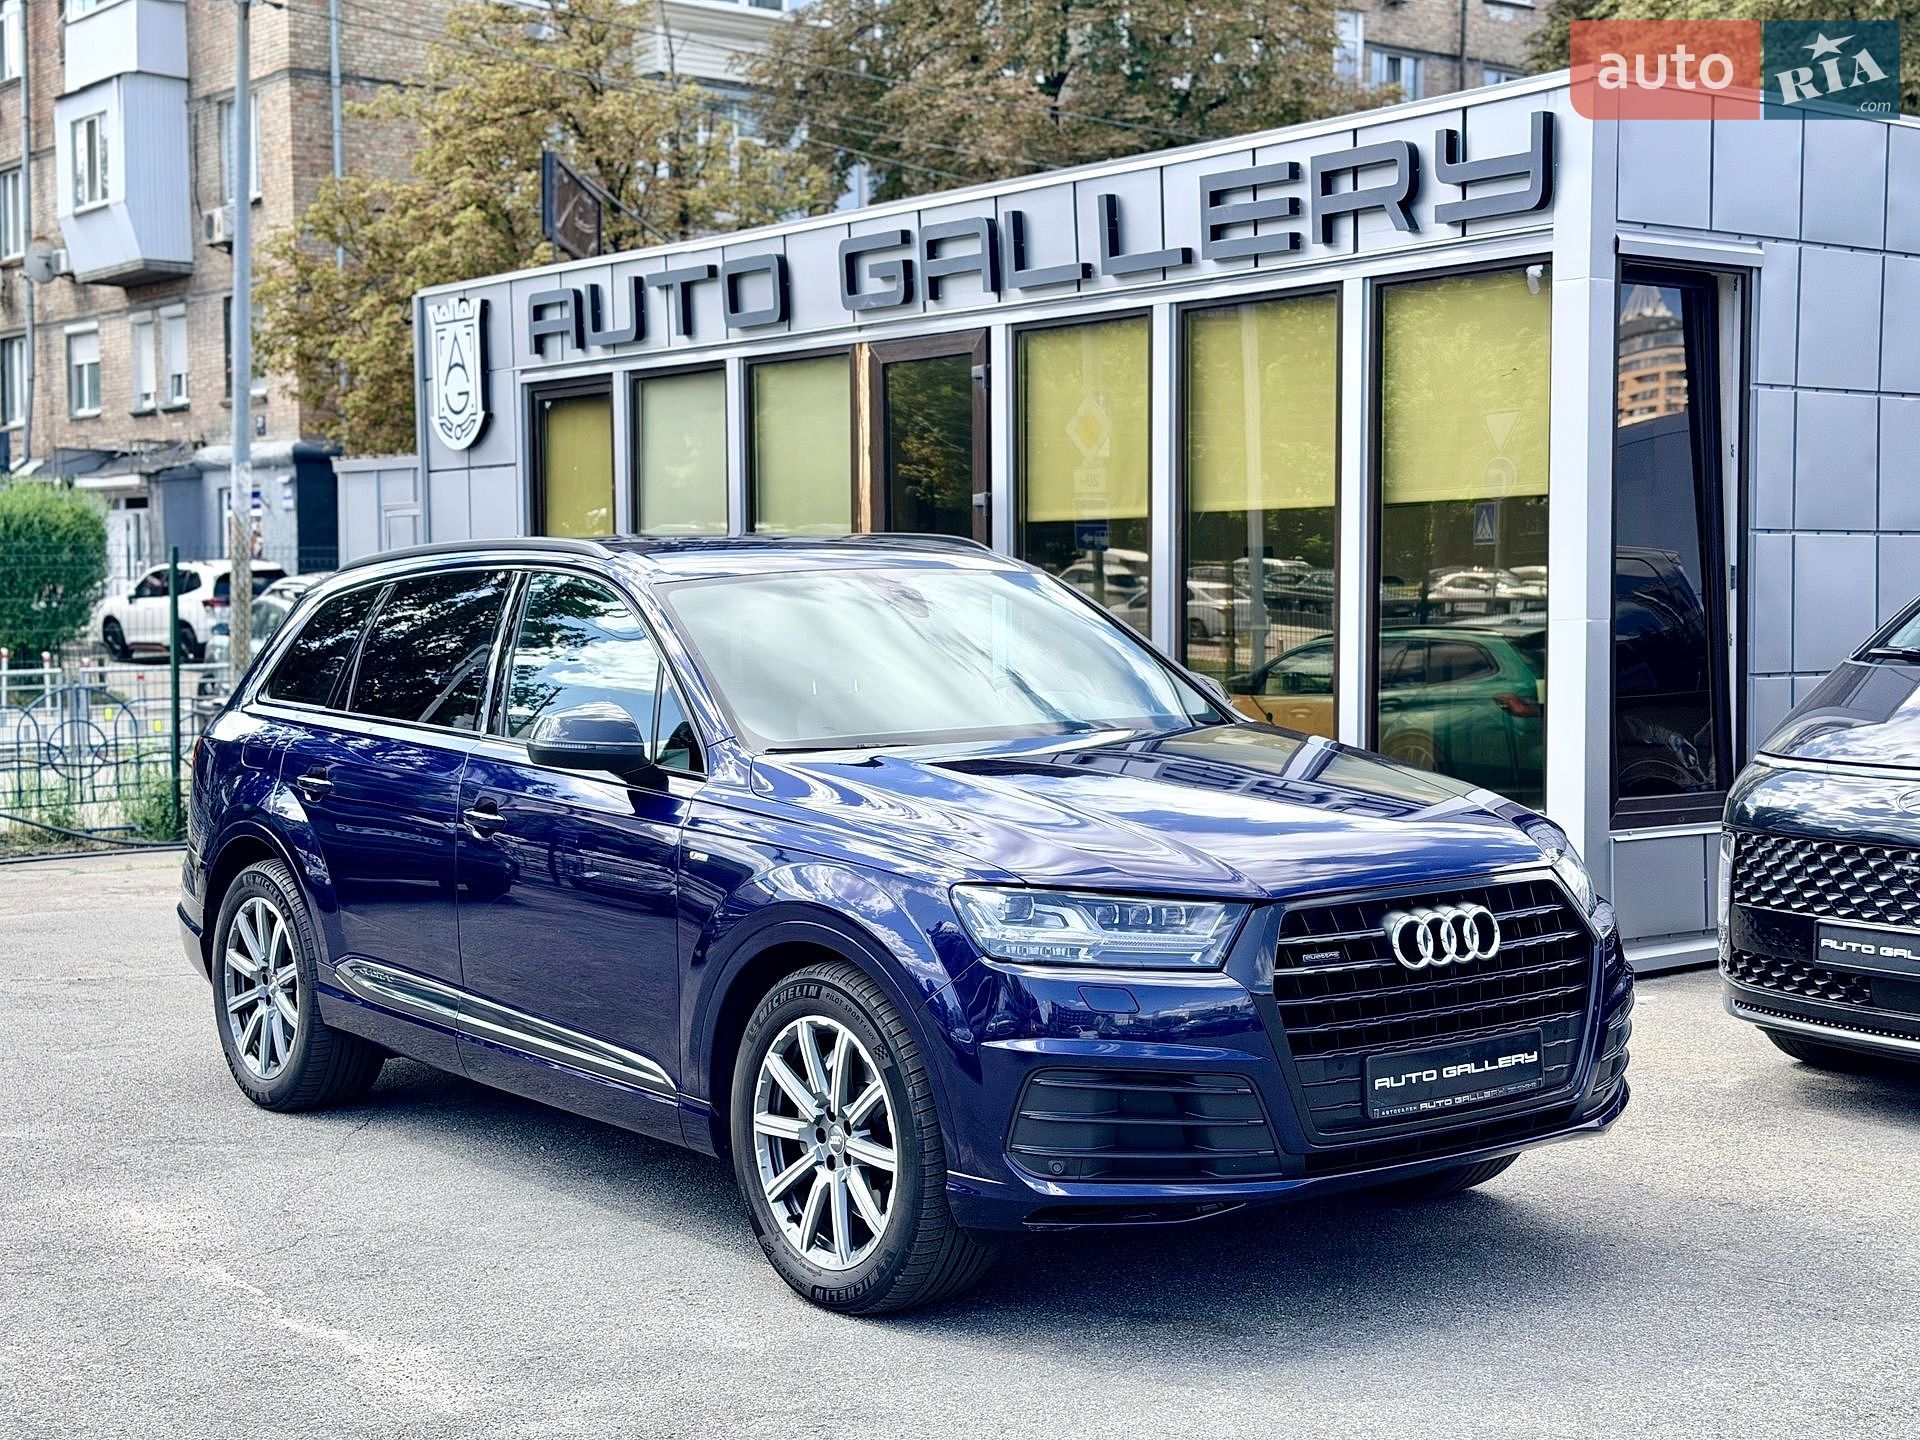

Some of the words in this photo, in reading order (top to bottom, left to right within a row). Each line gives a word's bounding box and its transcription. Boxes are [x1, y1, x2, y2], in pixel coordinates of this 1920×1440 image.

[528, 253, 791, 356] AUTO
[838, 110, 1555, 312] GALLERY
[1820, 938, 1875, 955] AUTO
[759, 984, 819, 1023] MICHELIN
[825, 992, 844, 1006] PILOT
[844, 1004, 864, 1026] SPORT
[1374, 1069, 1438, 1091] AUTO
[1442, 1050, 1538, 1078] GALLERY
[1420, 1098, 1453, 1111] AUTO
[1454, 1087, 1505, 1104] GALLERY
[815, 1264, 881, 1301] MICHELIN
